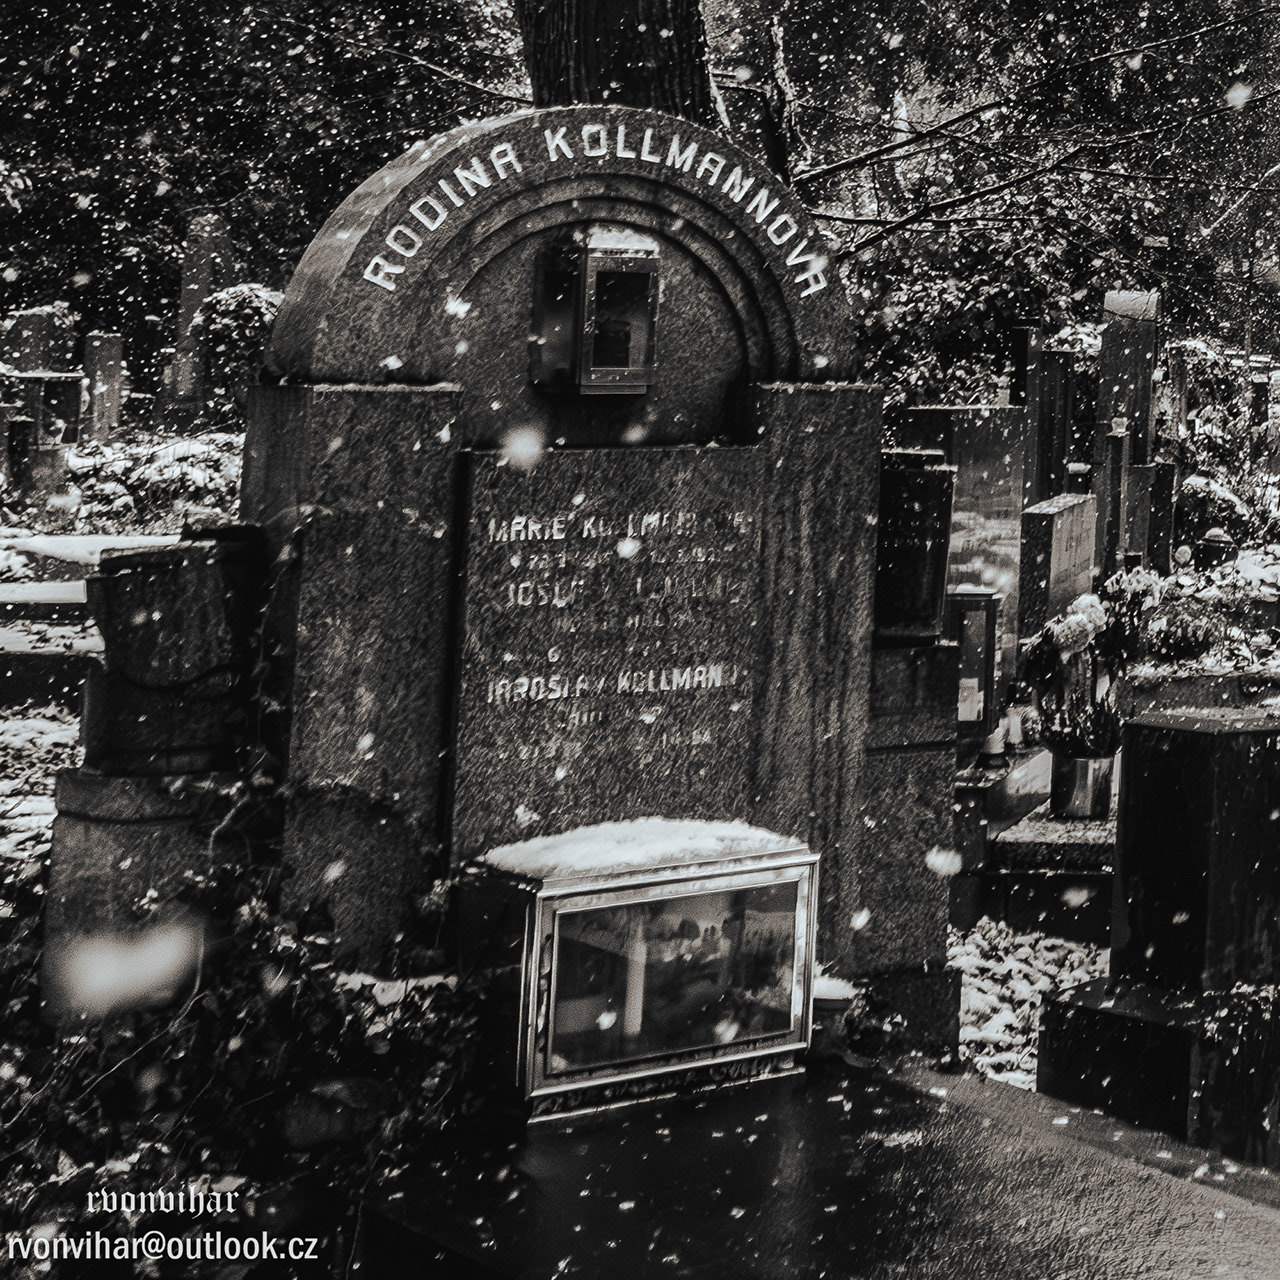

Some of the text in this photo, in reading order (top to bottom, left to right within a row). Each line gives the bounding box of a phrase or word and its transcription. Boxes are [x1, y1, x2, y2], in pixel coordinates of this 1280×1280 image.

[363, 123, 829, 298] RODINA KOLLMANNOVA
[488, 515, 567, 543] MARIE
